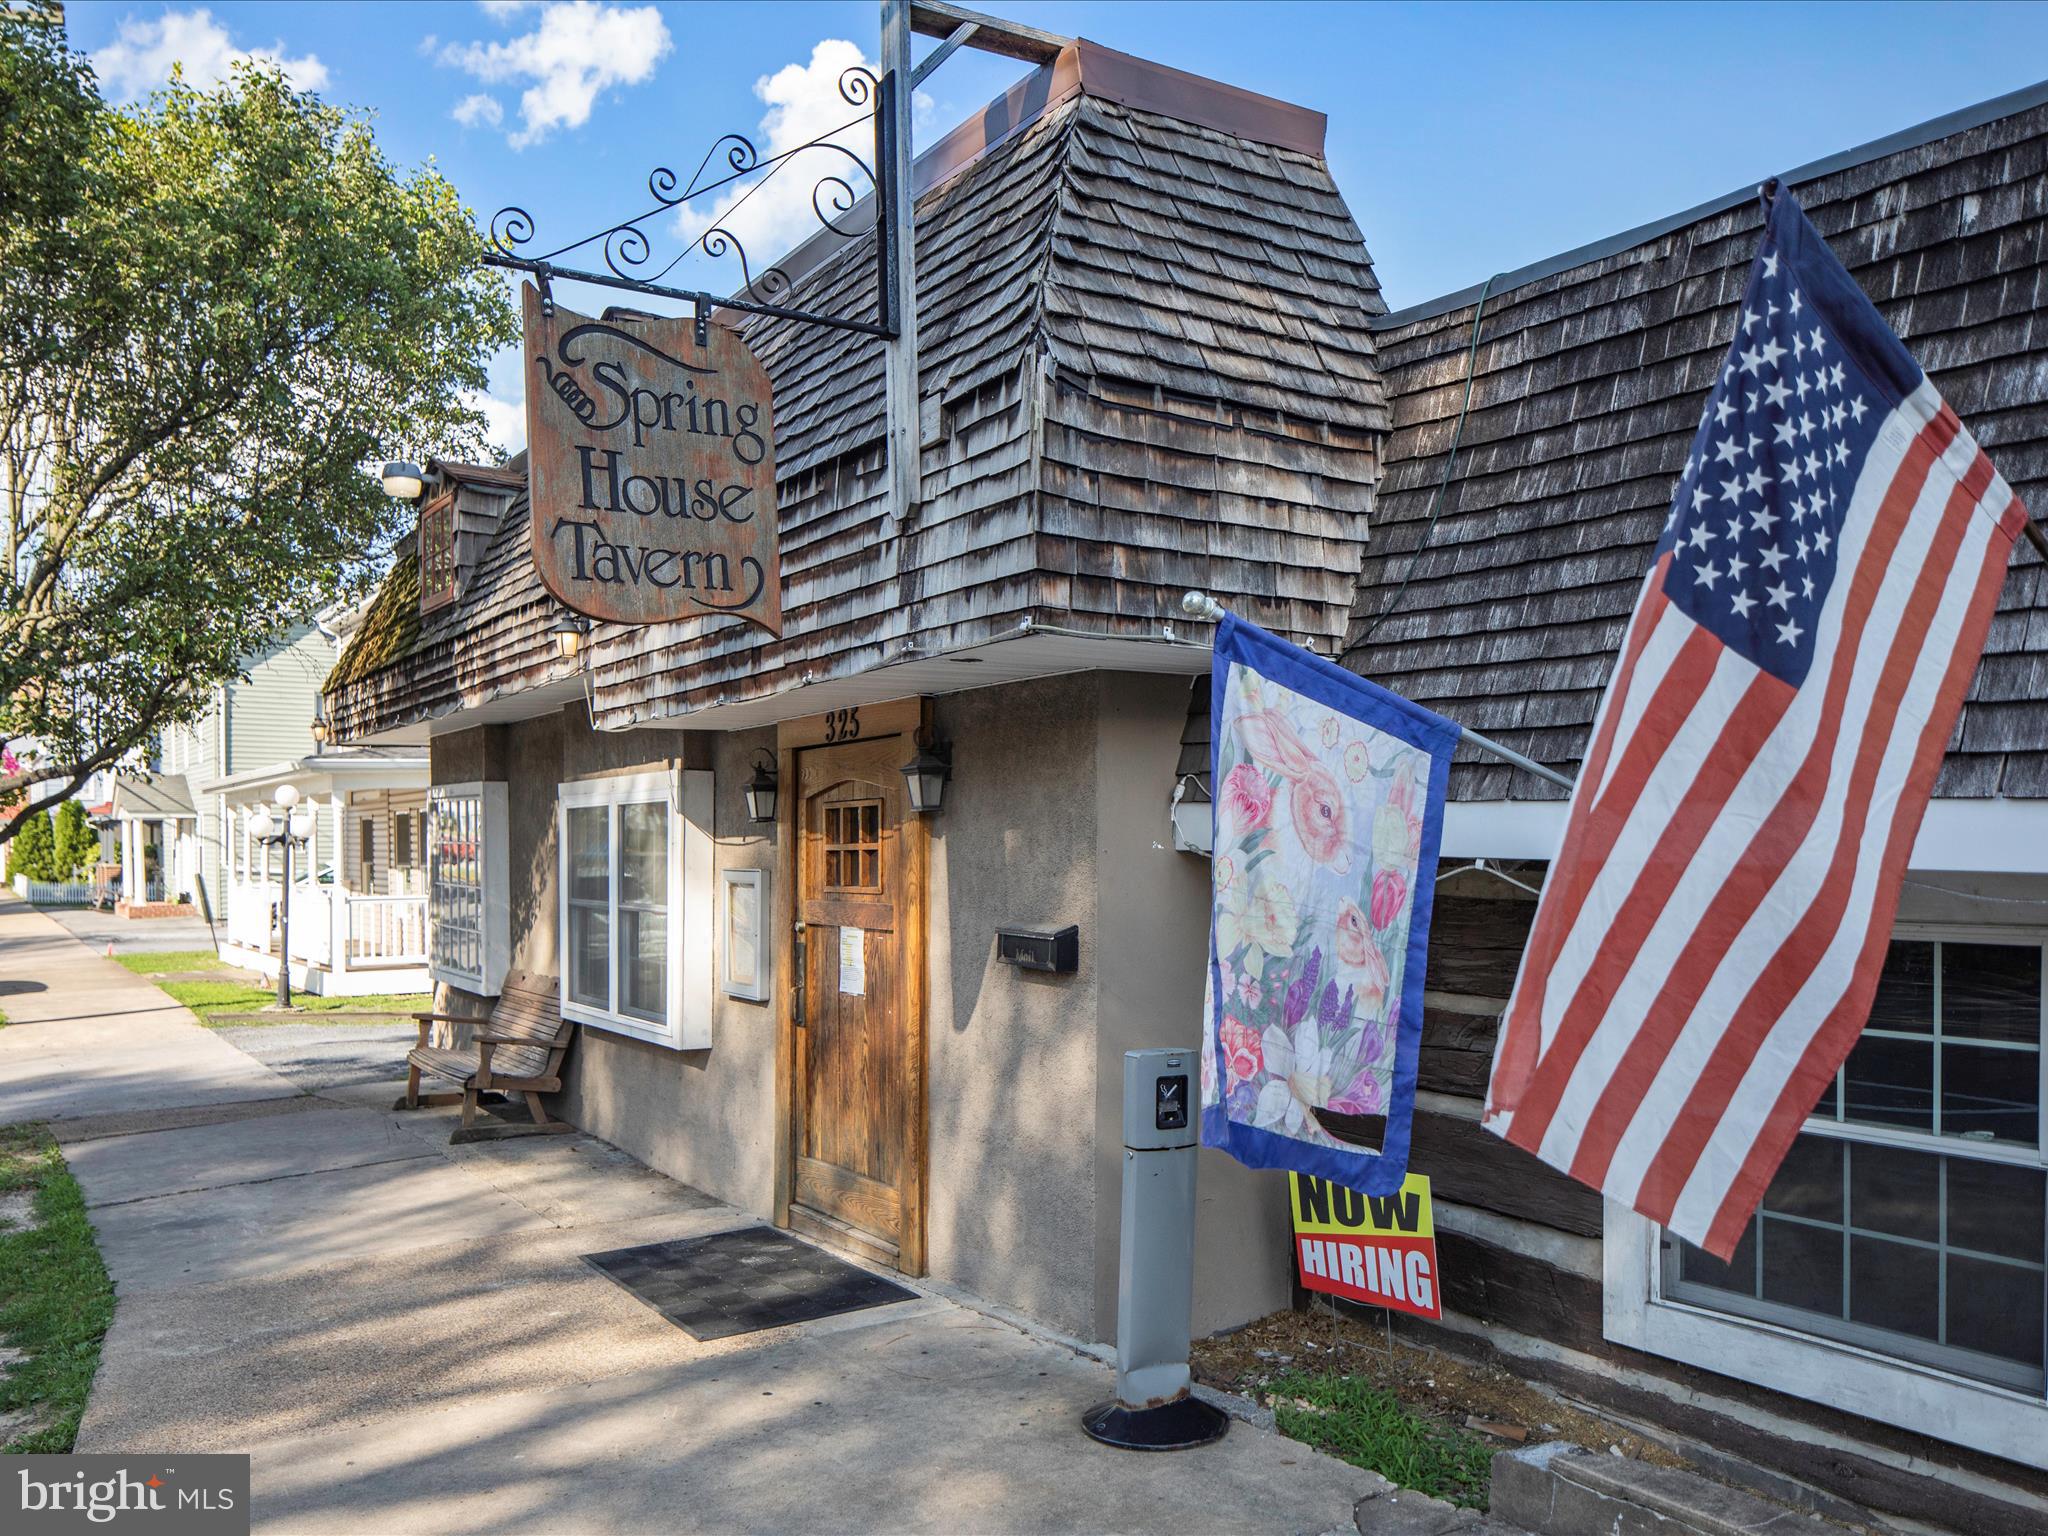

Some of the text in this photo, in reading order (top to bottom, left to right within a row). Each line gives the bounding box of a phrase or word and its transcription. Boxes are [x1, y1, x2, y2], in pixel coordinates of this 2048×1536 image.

[551, 361, 765, 465] Spring
[575, 445, 754, 523] House
[551, 517, 734, 591] Tavern
[825, 706, 860, 742] 325
[1299, 1174, 1420, 1232] NOW
[1301, 1238, 1434, 1310] HIRING
